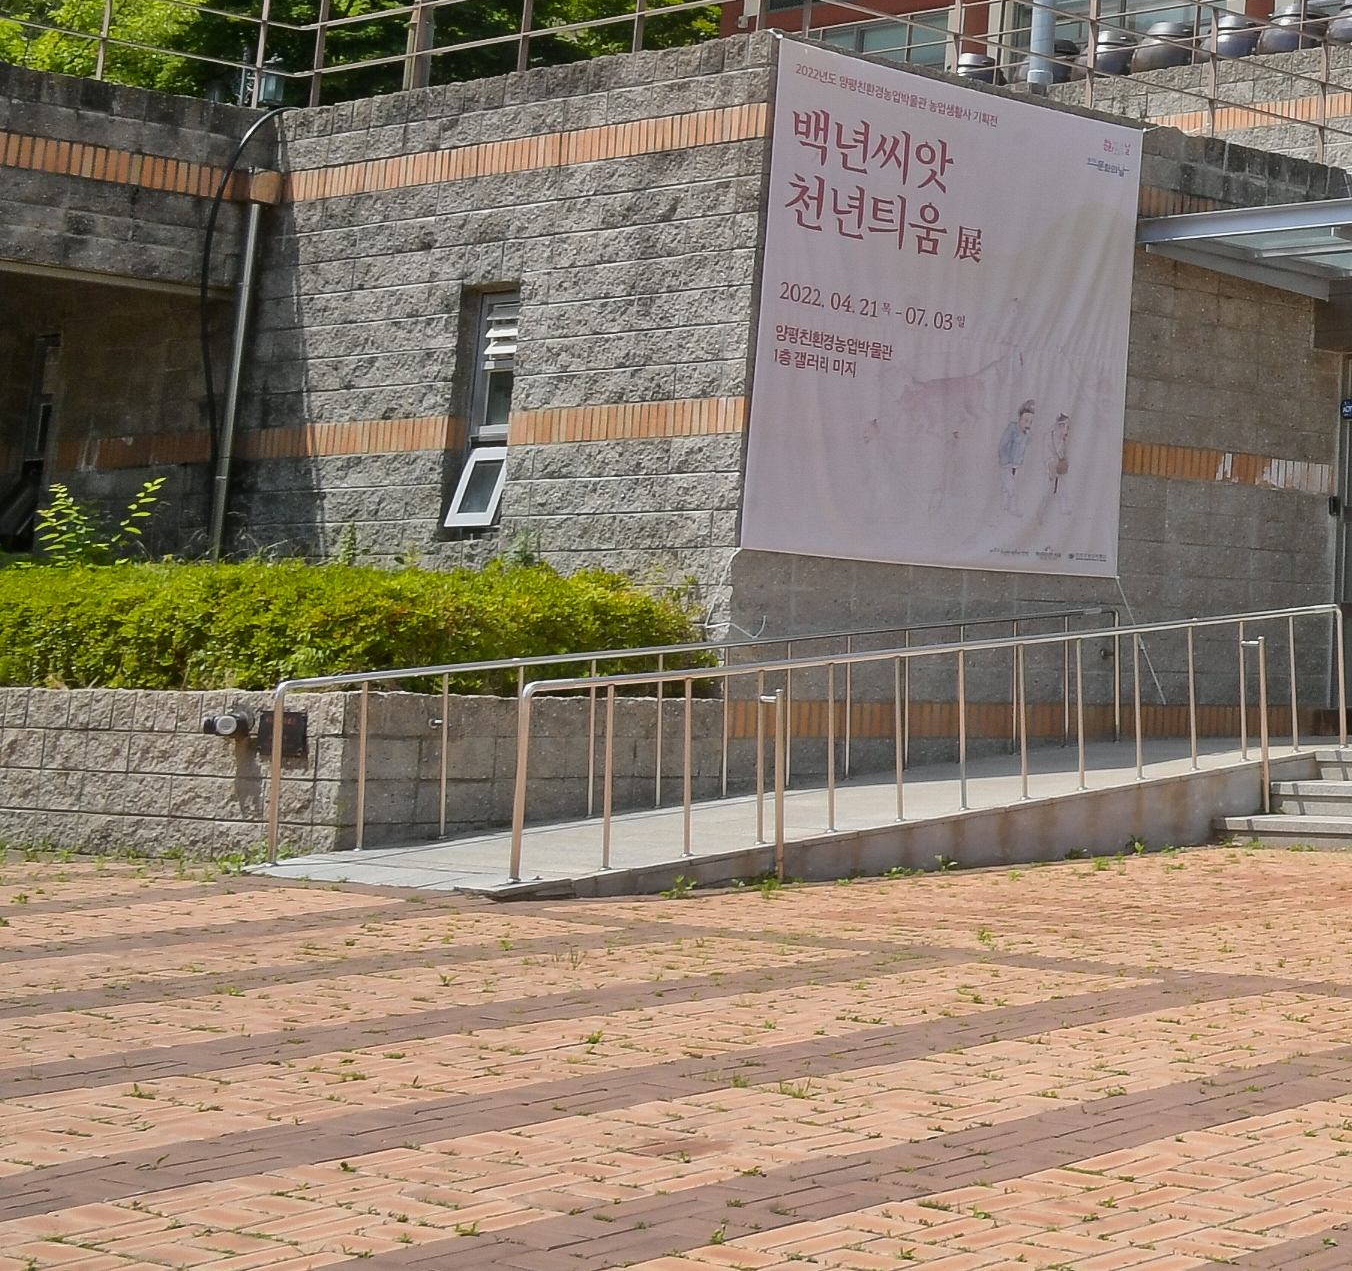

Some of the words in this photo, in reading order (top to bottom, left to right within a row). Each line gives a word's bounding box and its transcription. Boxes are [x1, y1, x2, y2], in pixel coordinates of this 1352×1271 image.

[796, 63, 837, 85] 2022년도
[839, 76, 928, 110] 양평친환경농업박물관
[929, 99, 972, 121] 농업생활사
[974, 111, 998, 128] 기획전
[792, 109, 955, 194] 백년씨앗
[784, 173, 948, 256] 천년틔움
[953, 225, 983, 263] 展
[779, 281, 825, 308] 2022.
[830, 292, 856, 313] 04.
[859, 298, 878, 318] 21
[882, 302, 892, 315] 목
[905, 306, 929, 327] 07.
[933, 311, 953, 330] 03
[956, 315, 966, 329] 일
[773, 348, 792, 366] 1층
[794, 351, 829, 373] 갤러리
[832, 359, 857, 378] 미지
[775, 324, 893, 361] 양평친환경농업박물관
